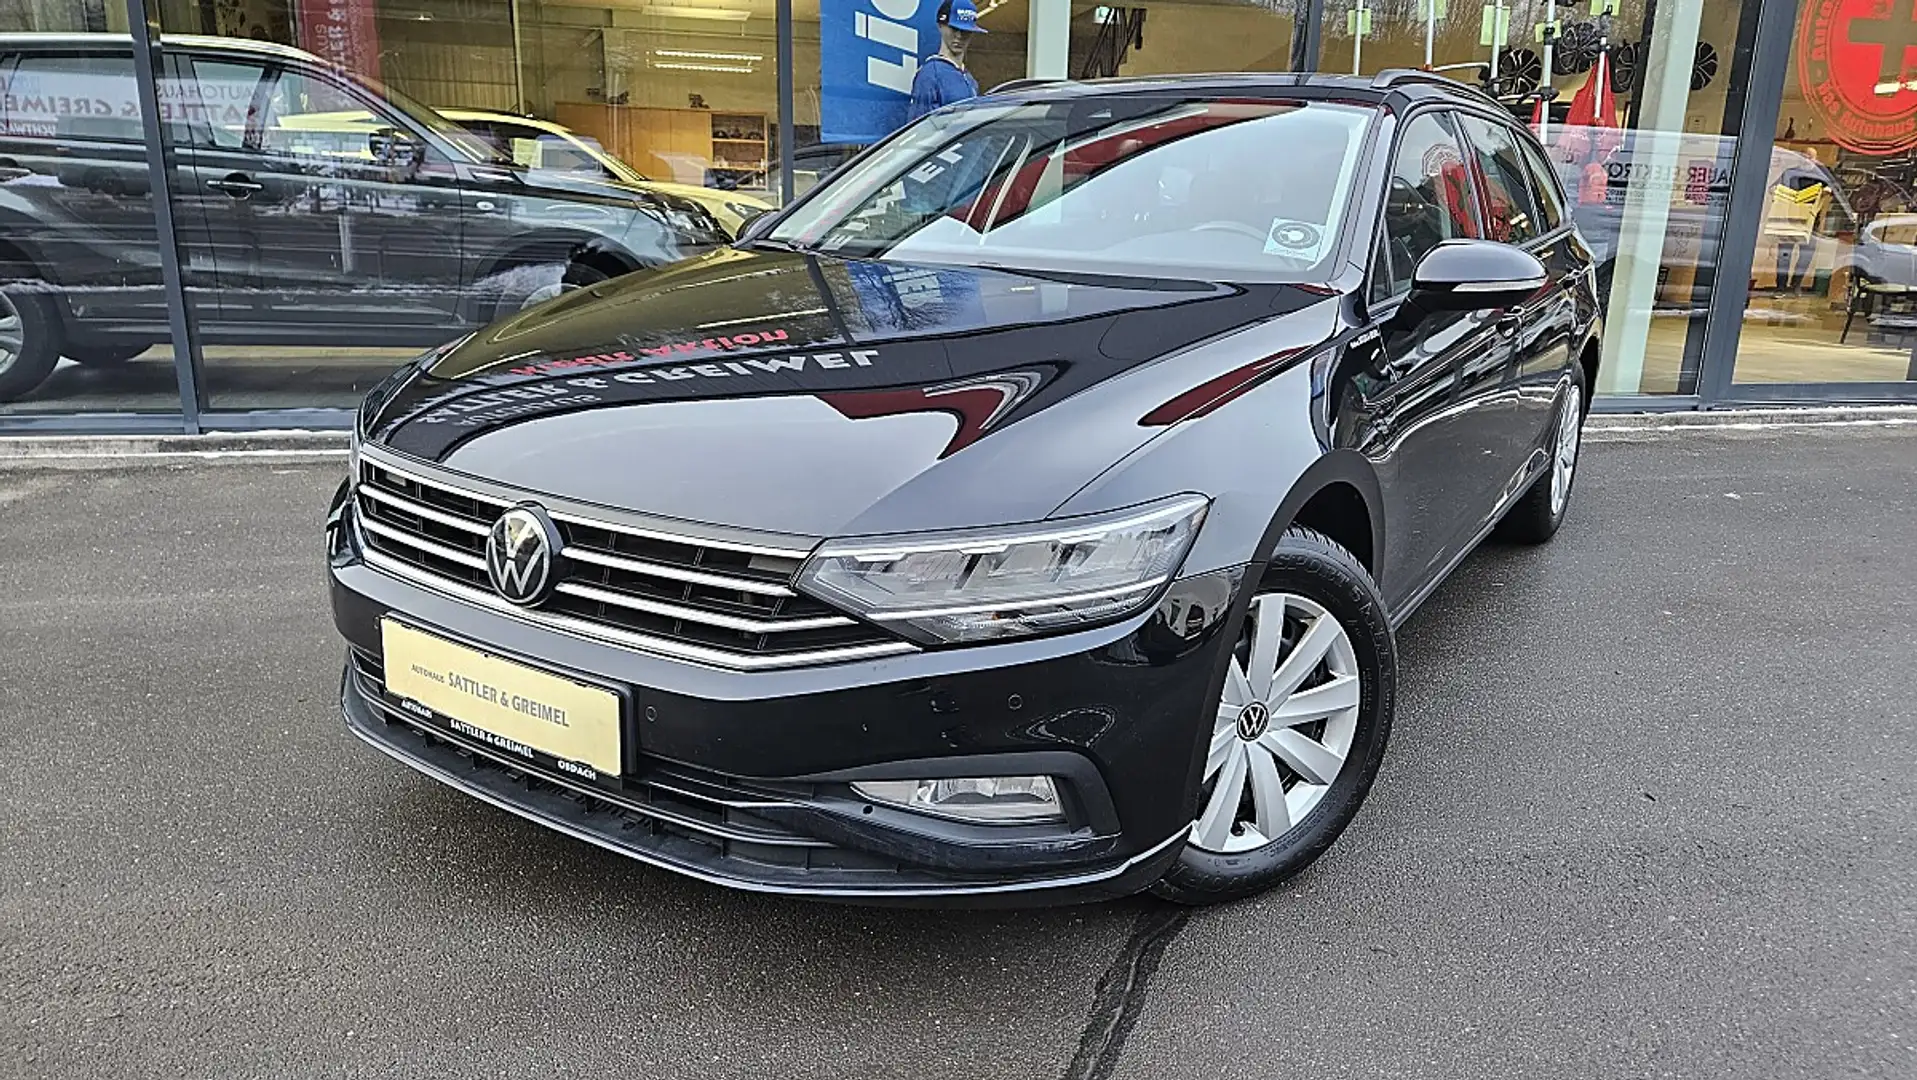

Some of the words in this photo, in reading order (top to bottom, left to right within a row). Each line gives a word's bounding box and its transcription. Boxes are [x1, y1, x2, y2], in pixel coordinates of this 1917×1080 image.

[411, 663, 445, 684] AUTOHAUS
[448, 671, 498, 704] SATTLER
[499, 691, 510, 708] &
[511, 694, 571, 728] GREIMEL
[450, 718, 488, 742] SATTLER
[485, 732, 494, 744] &
[494, 736, 534, 759] GREIMEL
